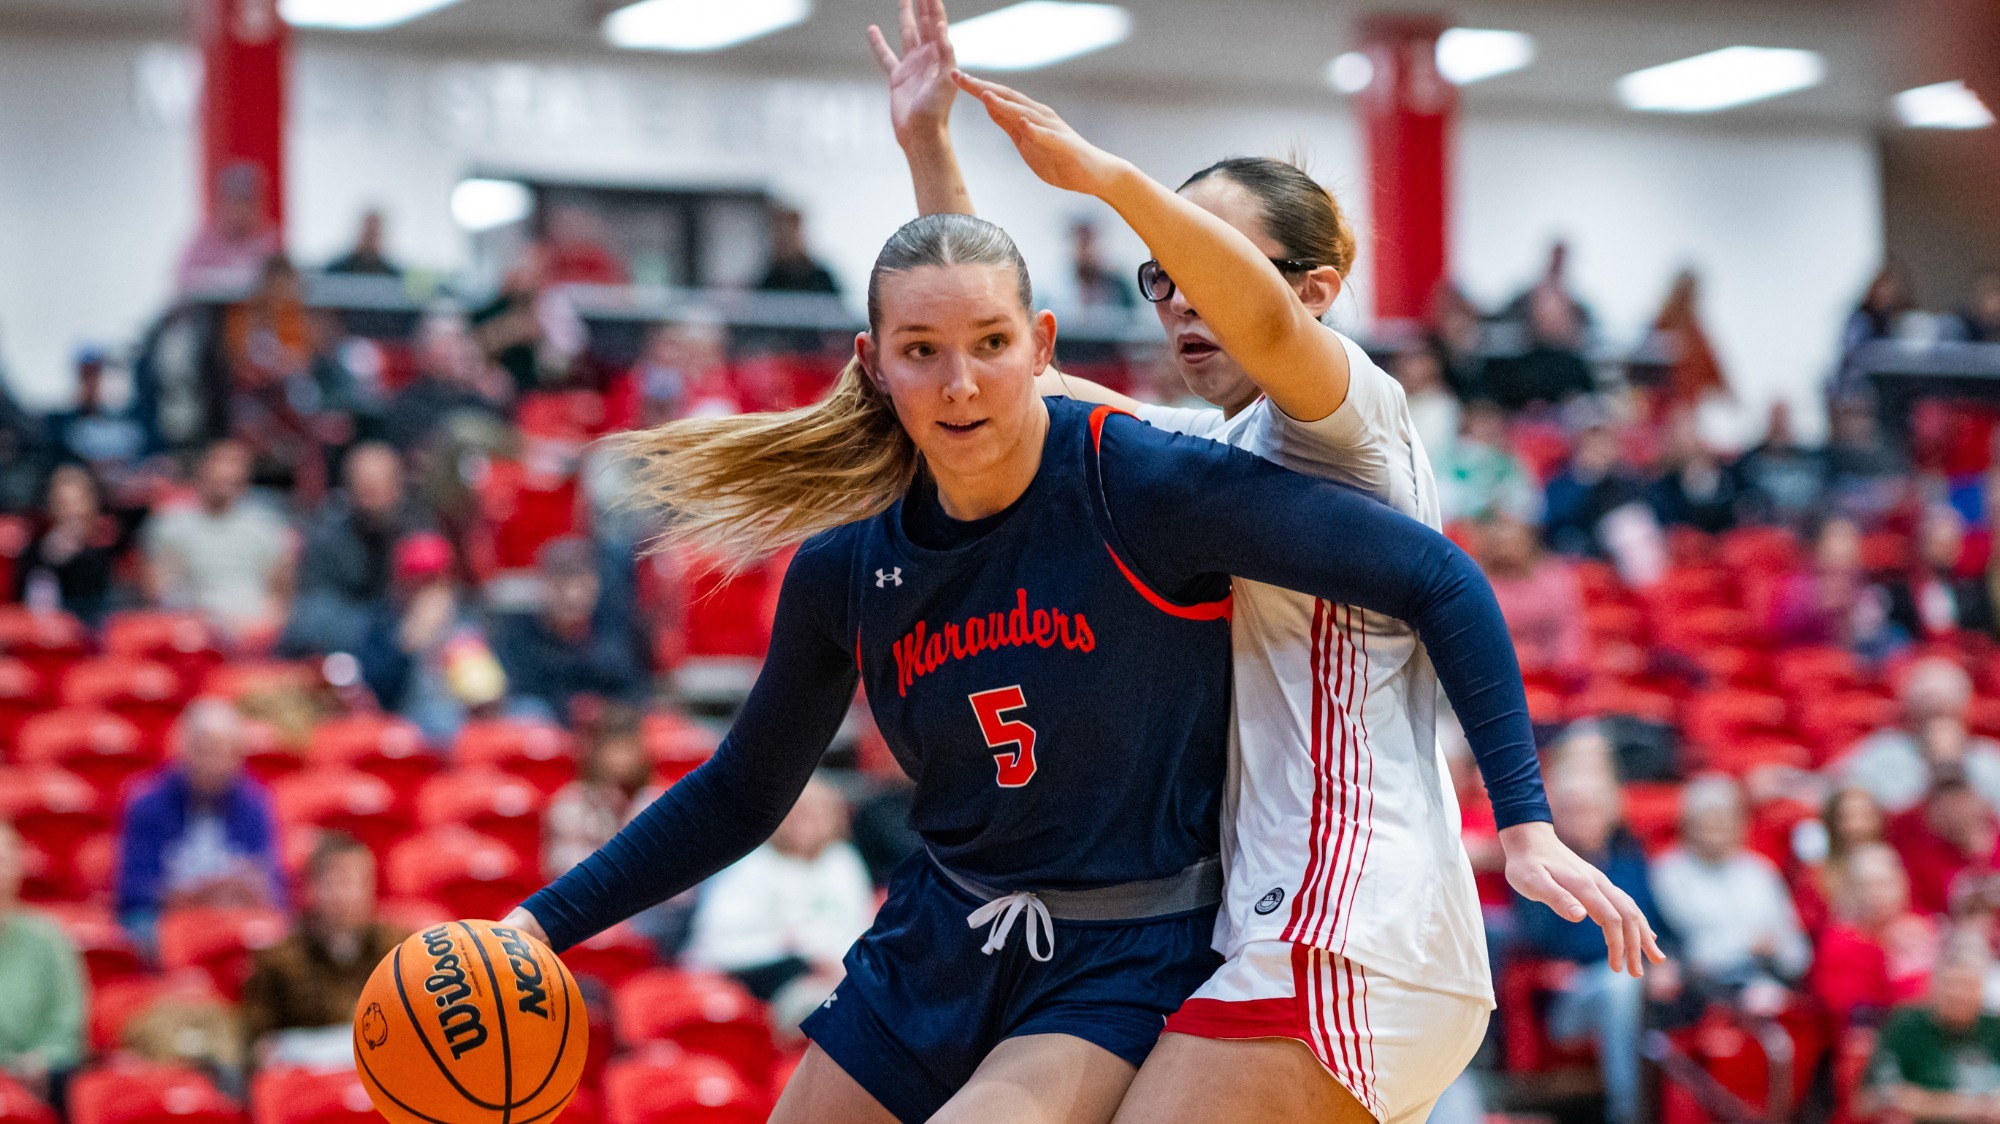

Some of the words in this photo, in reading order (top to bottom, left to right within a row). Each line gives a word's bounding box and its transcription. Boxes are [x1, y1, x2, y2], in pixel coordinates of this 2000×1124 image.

[893, 588, 1096, 697] Marauders
[968, 684, 1037, 788] 5
[421, 924, 488, 1061] Wilson
[490, 928, 548, 1019] NCAA
